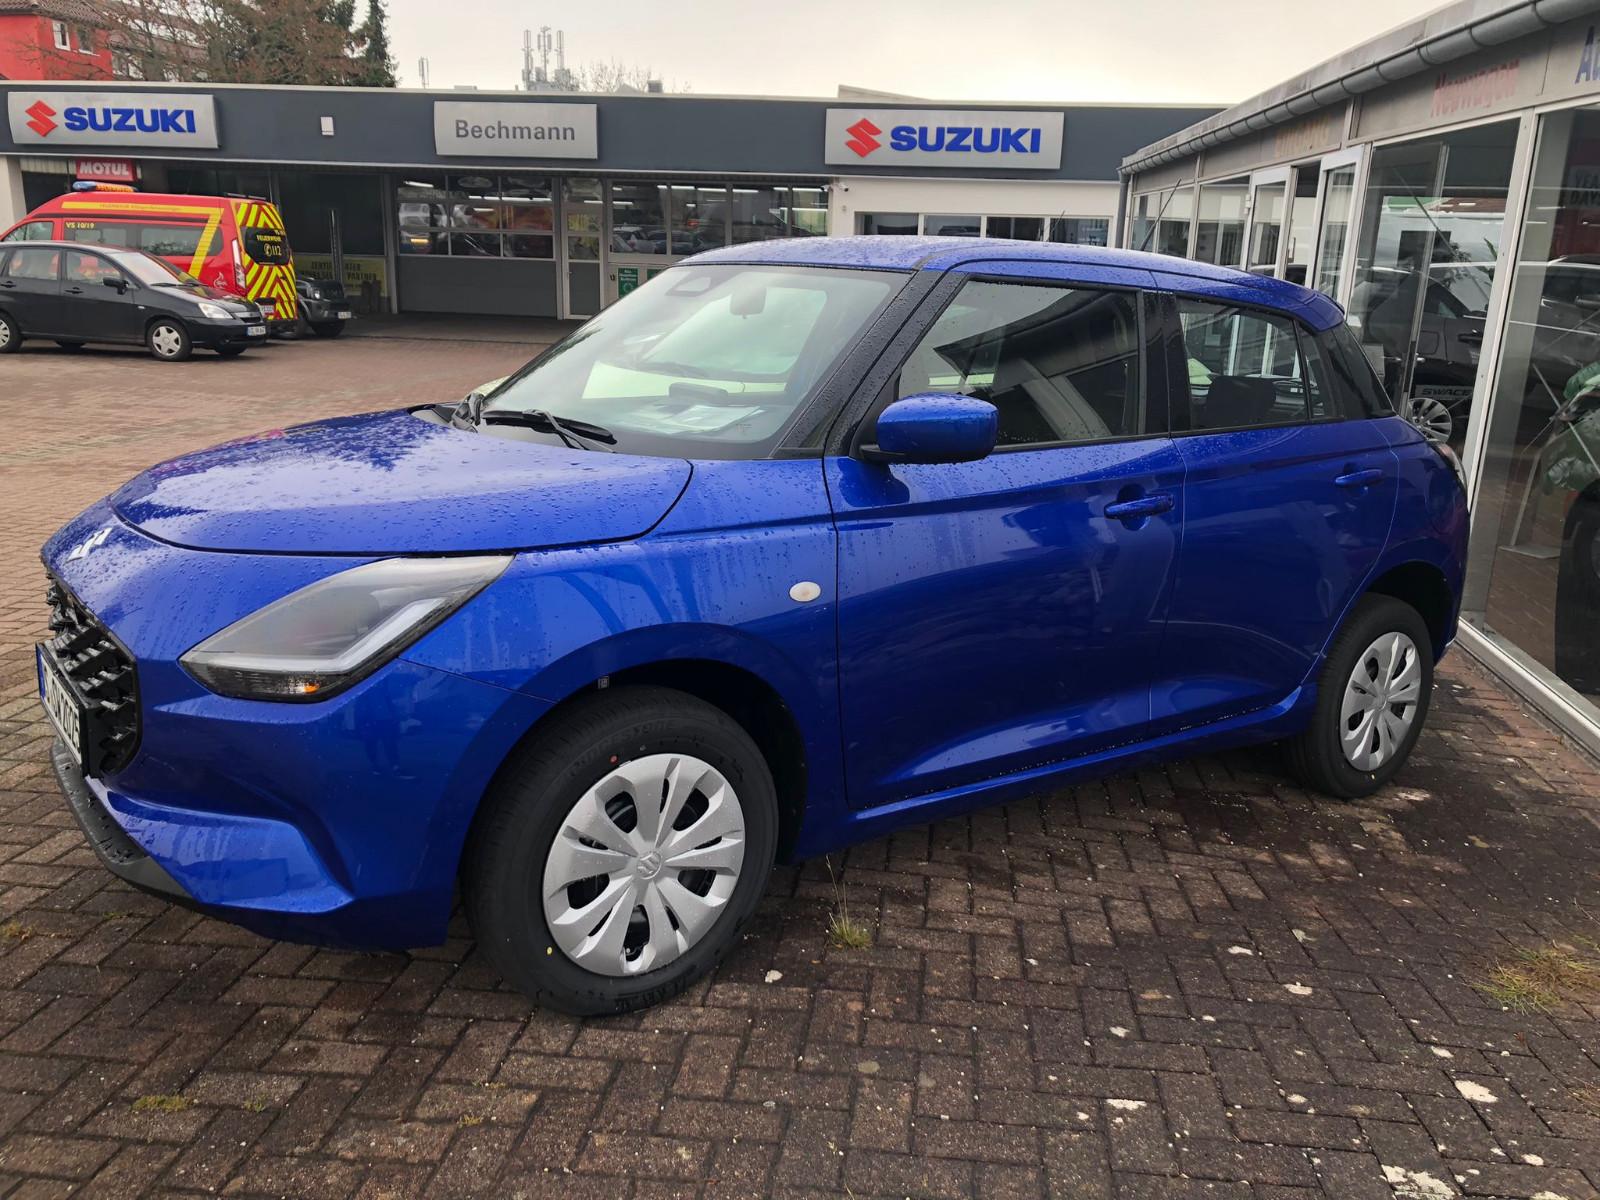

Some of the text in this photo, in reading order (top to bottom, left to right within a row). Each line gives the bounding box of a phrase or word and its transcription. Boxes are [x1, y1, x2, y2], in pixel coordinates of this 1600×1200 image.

[63, 107, 196, 133] SUZUKI
[455, 114, 575, 136] Bechmann
[889, 125, 1041, 153] SUZUKI
[79, 162, 130, 176] MOTUL
